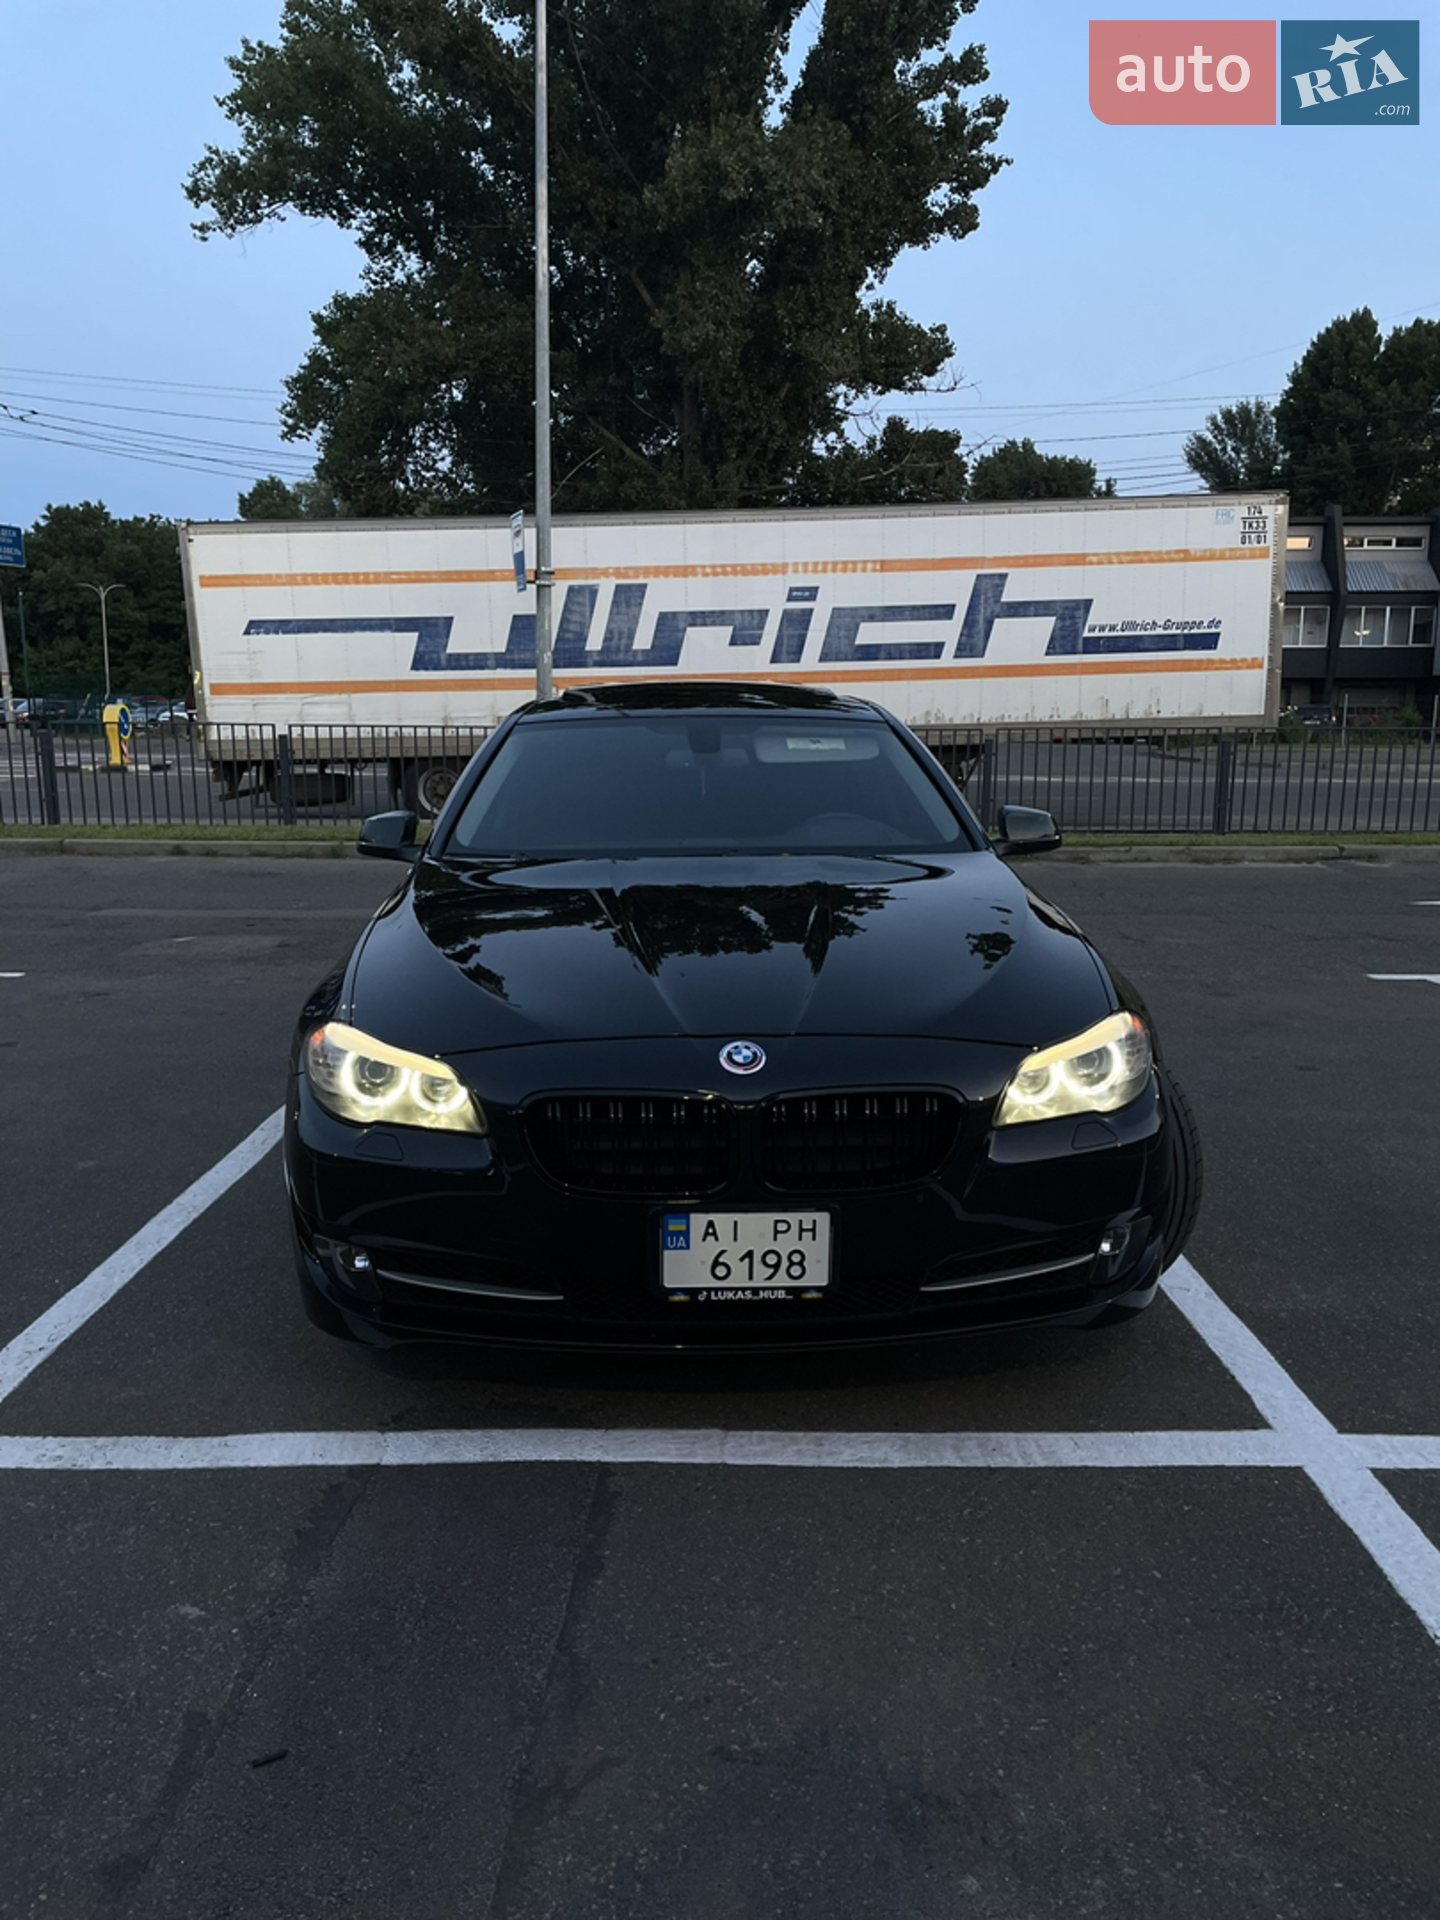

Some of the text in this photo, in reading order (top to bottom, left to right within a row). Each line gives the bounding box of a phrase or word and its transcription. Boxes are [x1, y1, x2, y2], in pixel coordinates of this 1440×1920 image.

[1087, 617, 1223, 633] www.Ullrich-Gruppe.de
[701, 1218, 818, 1243] AI PH
[667, 1236, 688, 1249] UA
[710, 1248, 807, 1282] 6198
